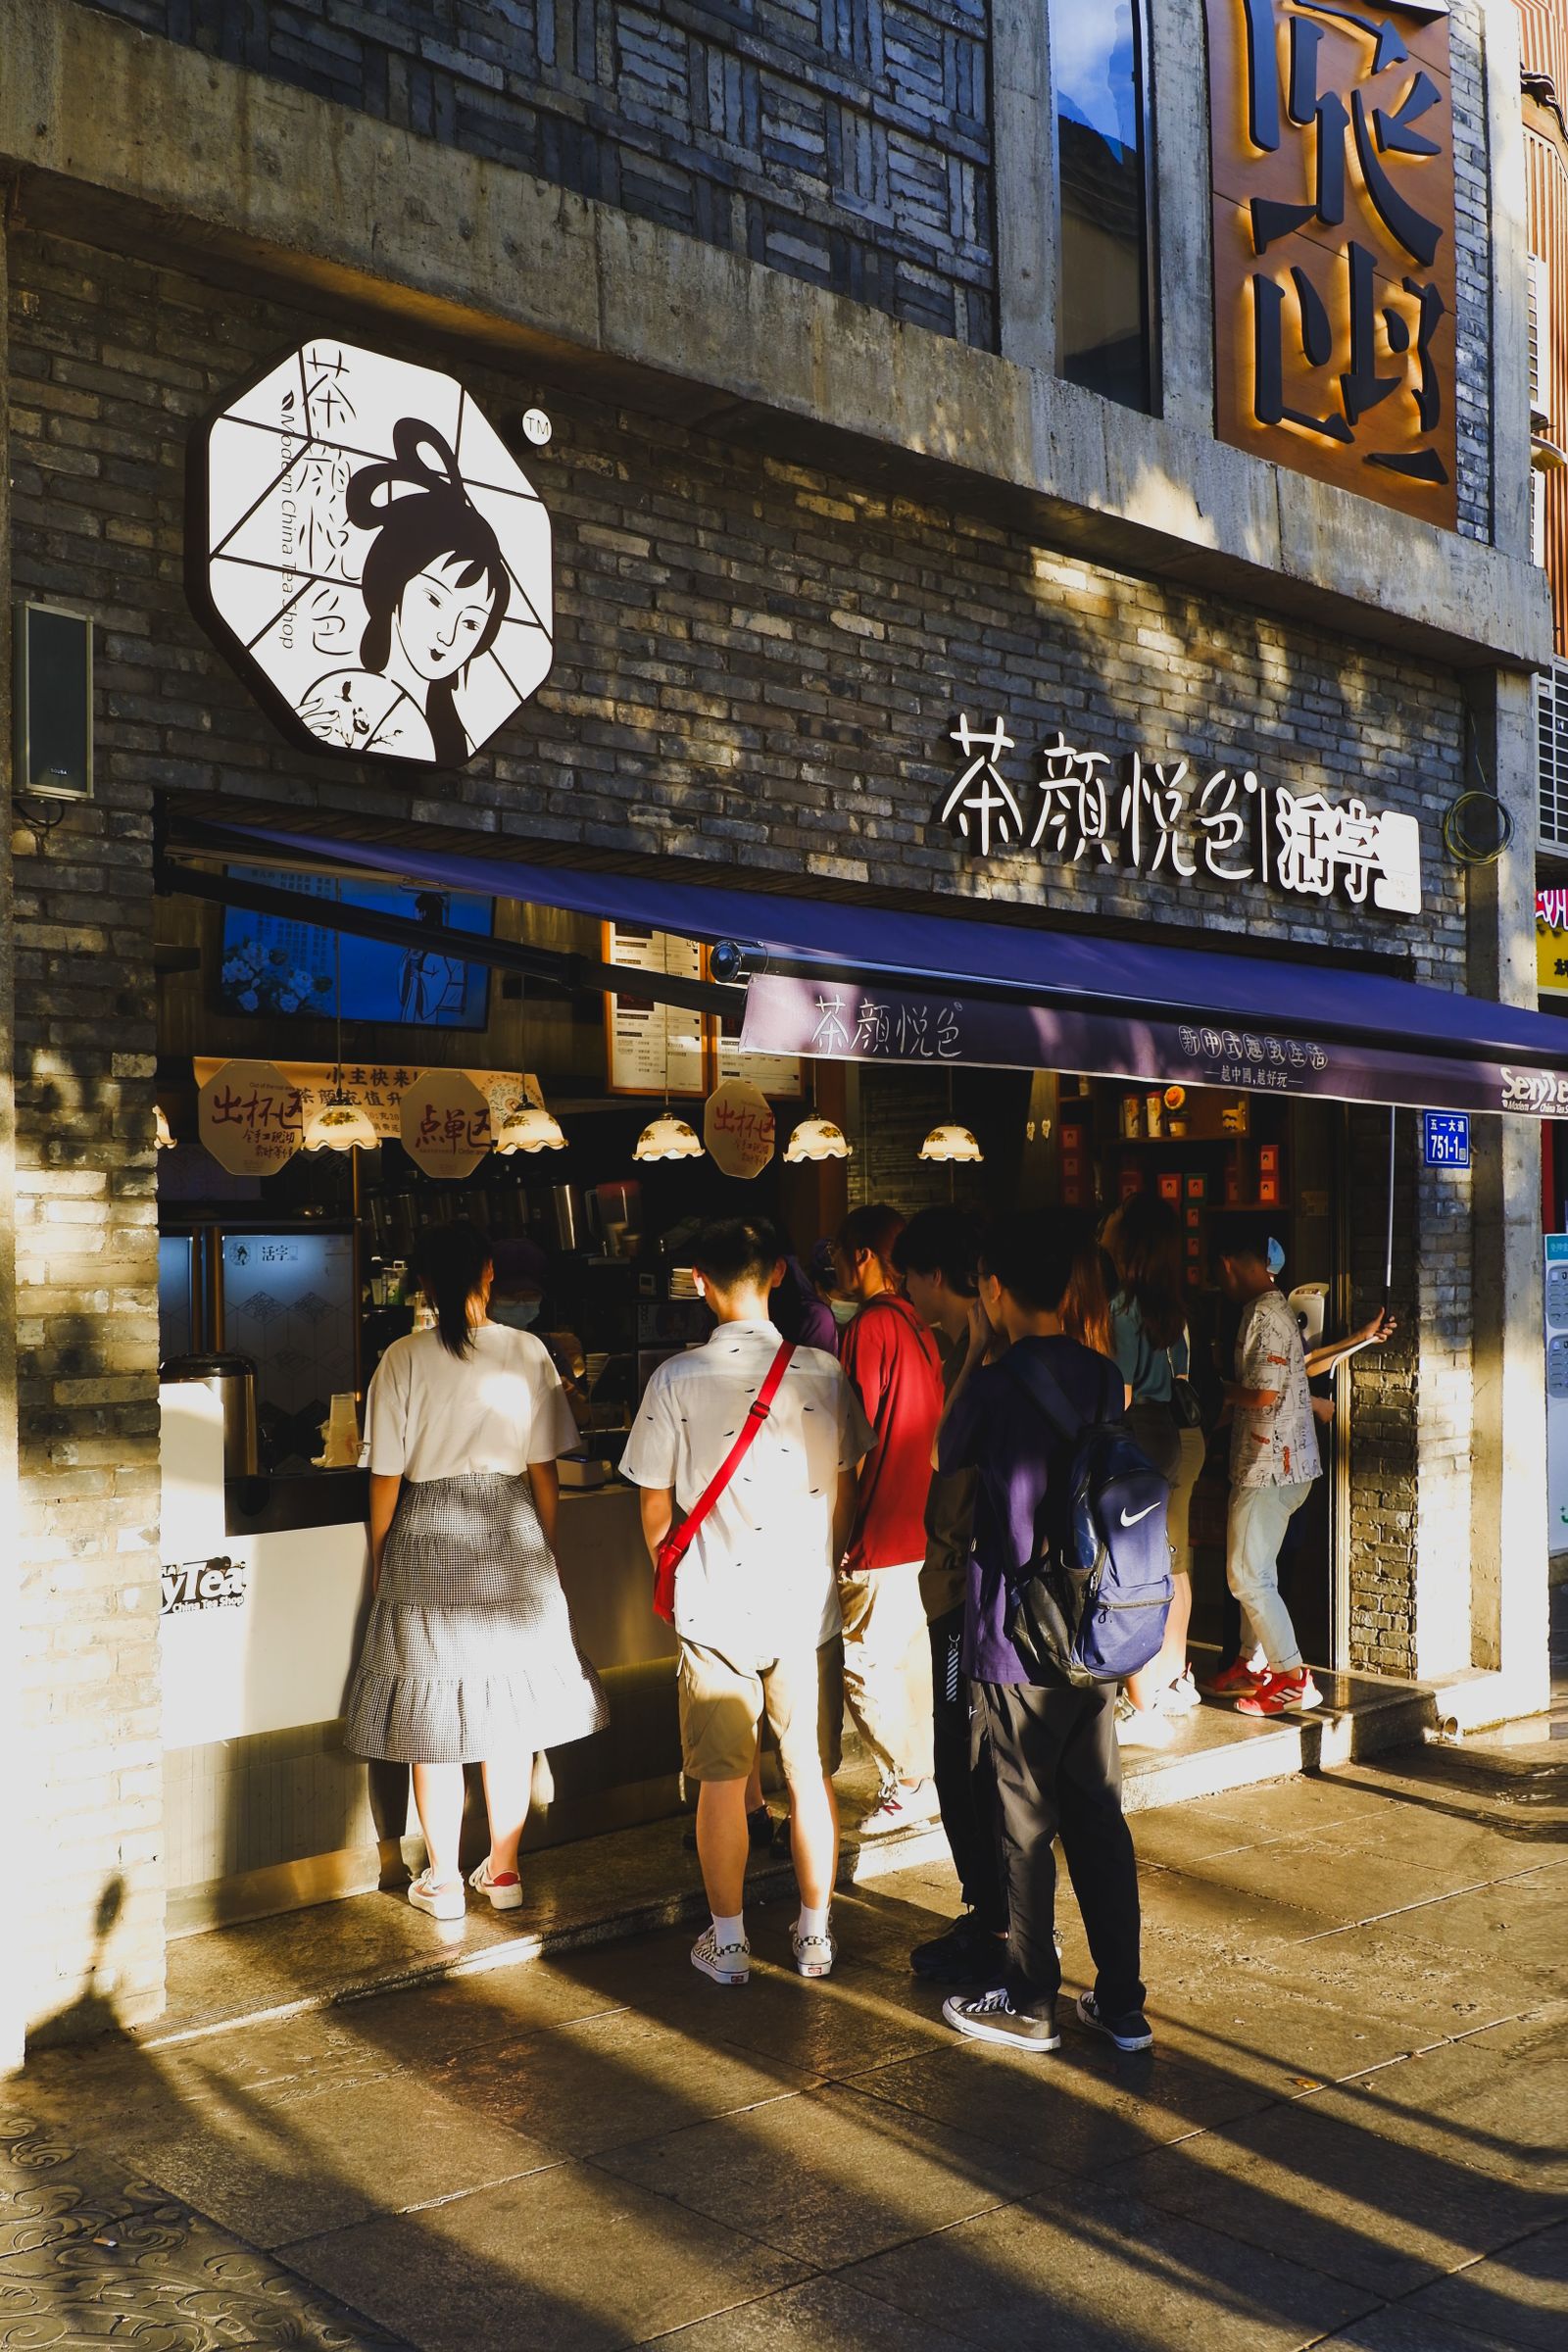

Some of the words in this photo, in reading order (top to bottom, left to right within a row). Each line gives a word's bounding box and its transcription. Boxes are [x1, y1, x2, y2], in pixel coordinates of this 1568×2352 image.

[525, 416, 550, 437] TM
[280, 414, 296, 495] Modern
[281, 500, 297, 556] China
[281, 562, 297, 594] Tea
[279, 597, 298, 649] Shop
[1430, 1118, 1465, 1133] 五一大道
[1431, 1135, 1459, 1159] 751-1
